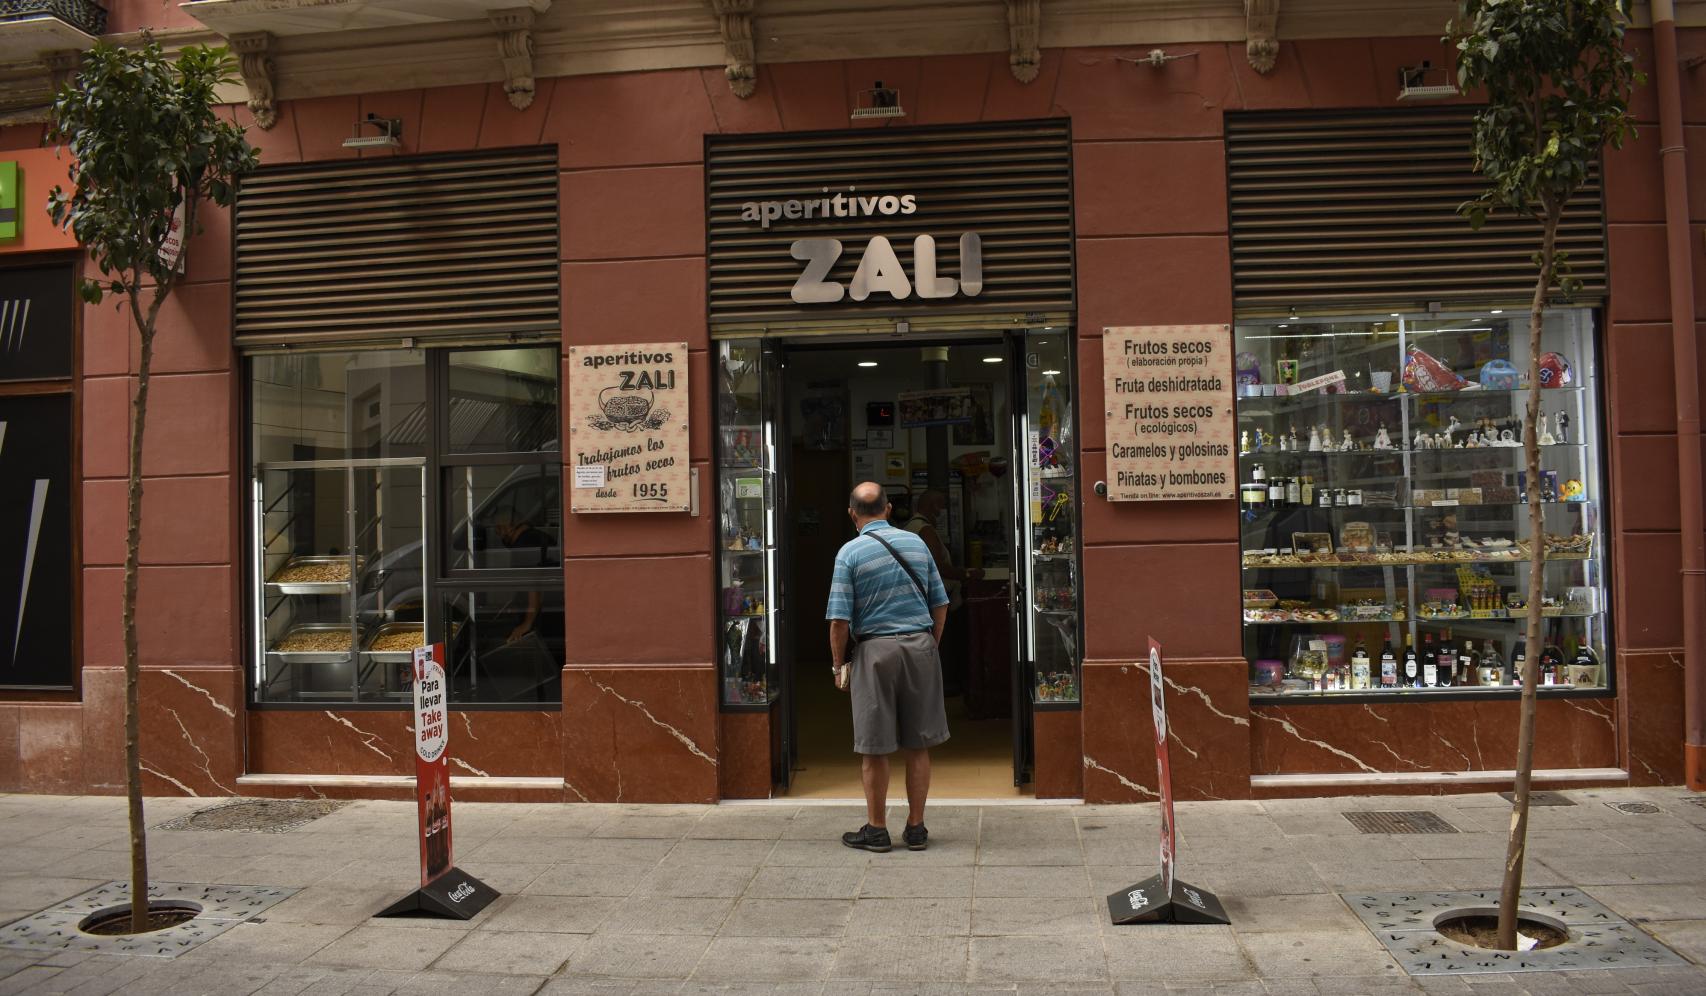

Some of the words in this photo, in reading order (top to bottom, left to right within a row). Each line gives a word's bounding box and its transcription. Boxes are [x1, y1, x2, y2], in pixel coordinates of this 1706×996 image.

[741, 186, 916, 228] aperitivos
[790, 232, 983, 303] ZALI
[1124, 340, 1167, 355] Frutos
[1172, 341, 1212, 354] secos
[584, 351, 673, 369] aperitivos
[619, 370, 675, 390] ZALI
[1115, 378, 1144, 393] Fruta
[1148, 376, 1222, 392] deshidratada
[1125, 404, 1169, 419] Frutos
[1173, 405, 1213, 418] secos
[578, 444, 642, 466] Trabajamos
[647, 438, 664, 452] los
[1112, 443, 1167, 458] Caramelos
[1169, 445, 1176, 461] y
[1178, 441, 1229, 460] golosinas
[607, 464, 640, 481] frutos
[645, 456, 675, 471] secos
[1117, 471, 1157, 486] Piñatas
[1160, 474, 1167, 489] y
[1169, 469, 1226, 485] bombones
[595, 488, 617, 498] desde
[633, 483, 668, 497] 1955
[421, 679, 439, 694] Para
[420, 693, 441, 709] llevar
[421, 709, 442, 727] Take
[421, 723, 443, 742] away
